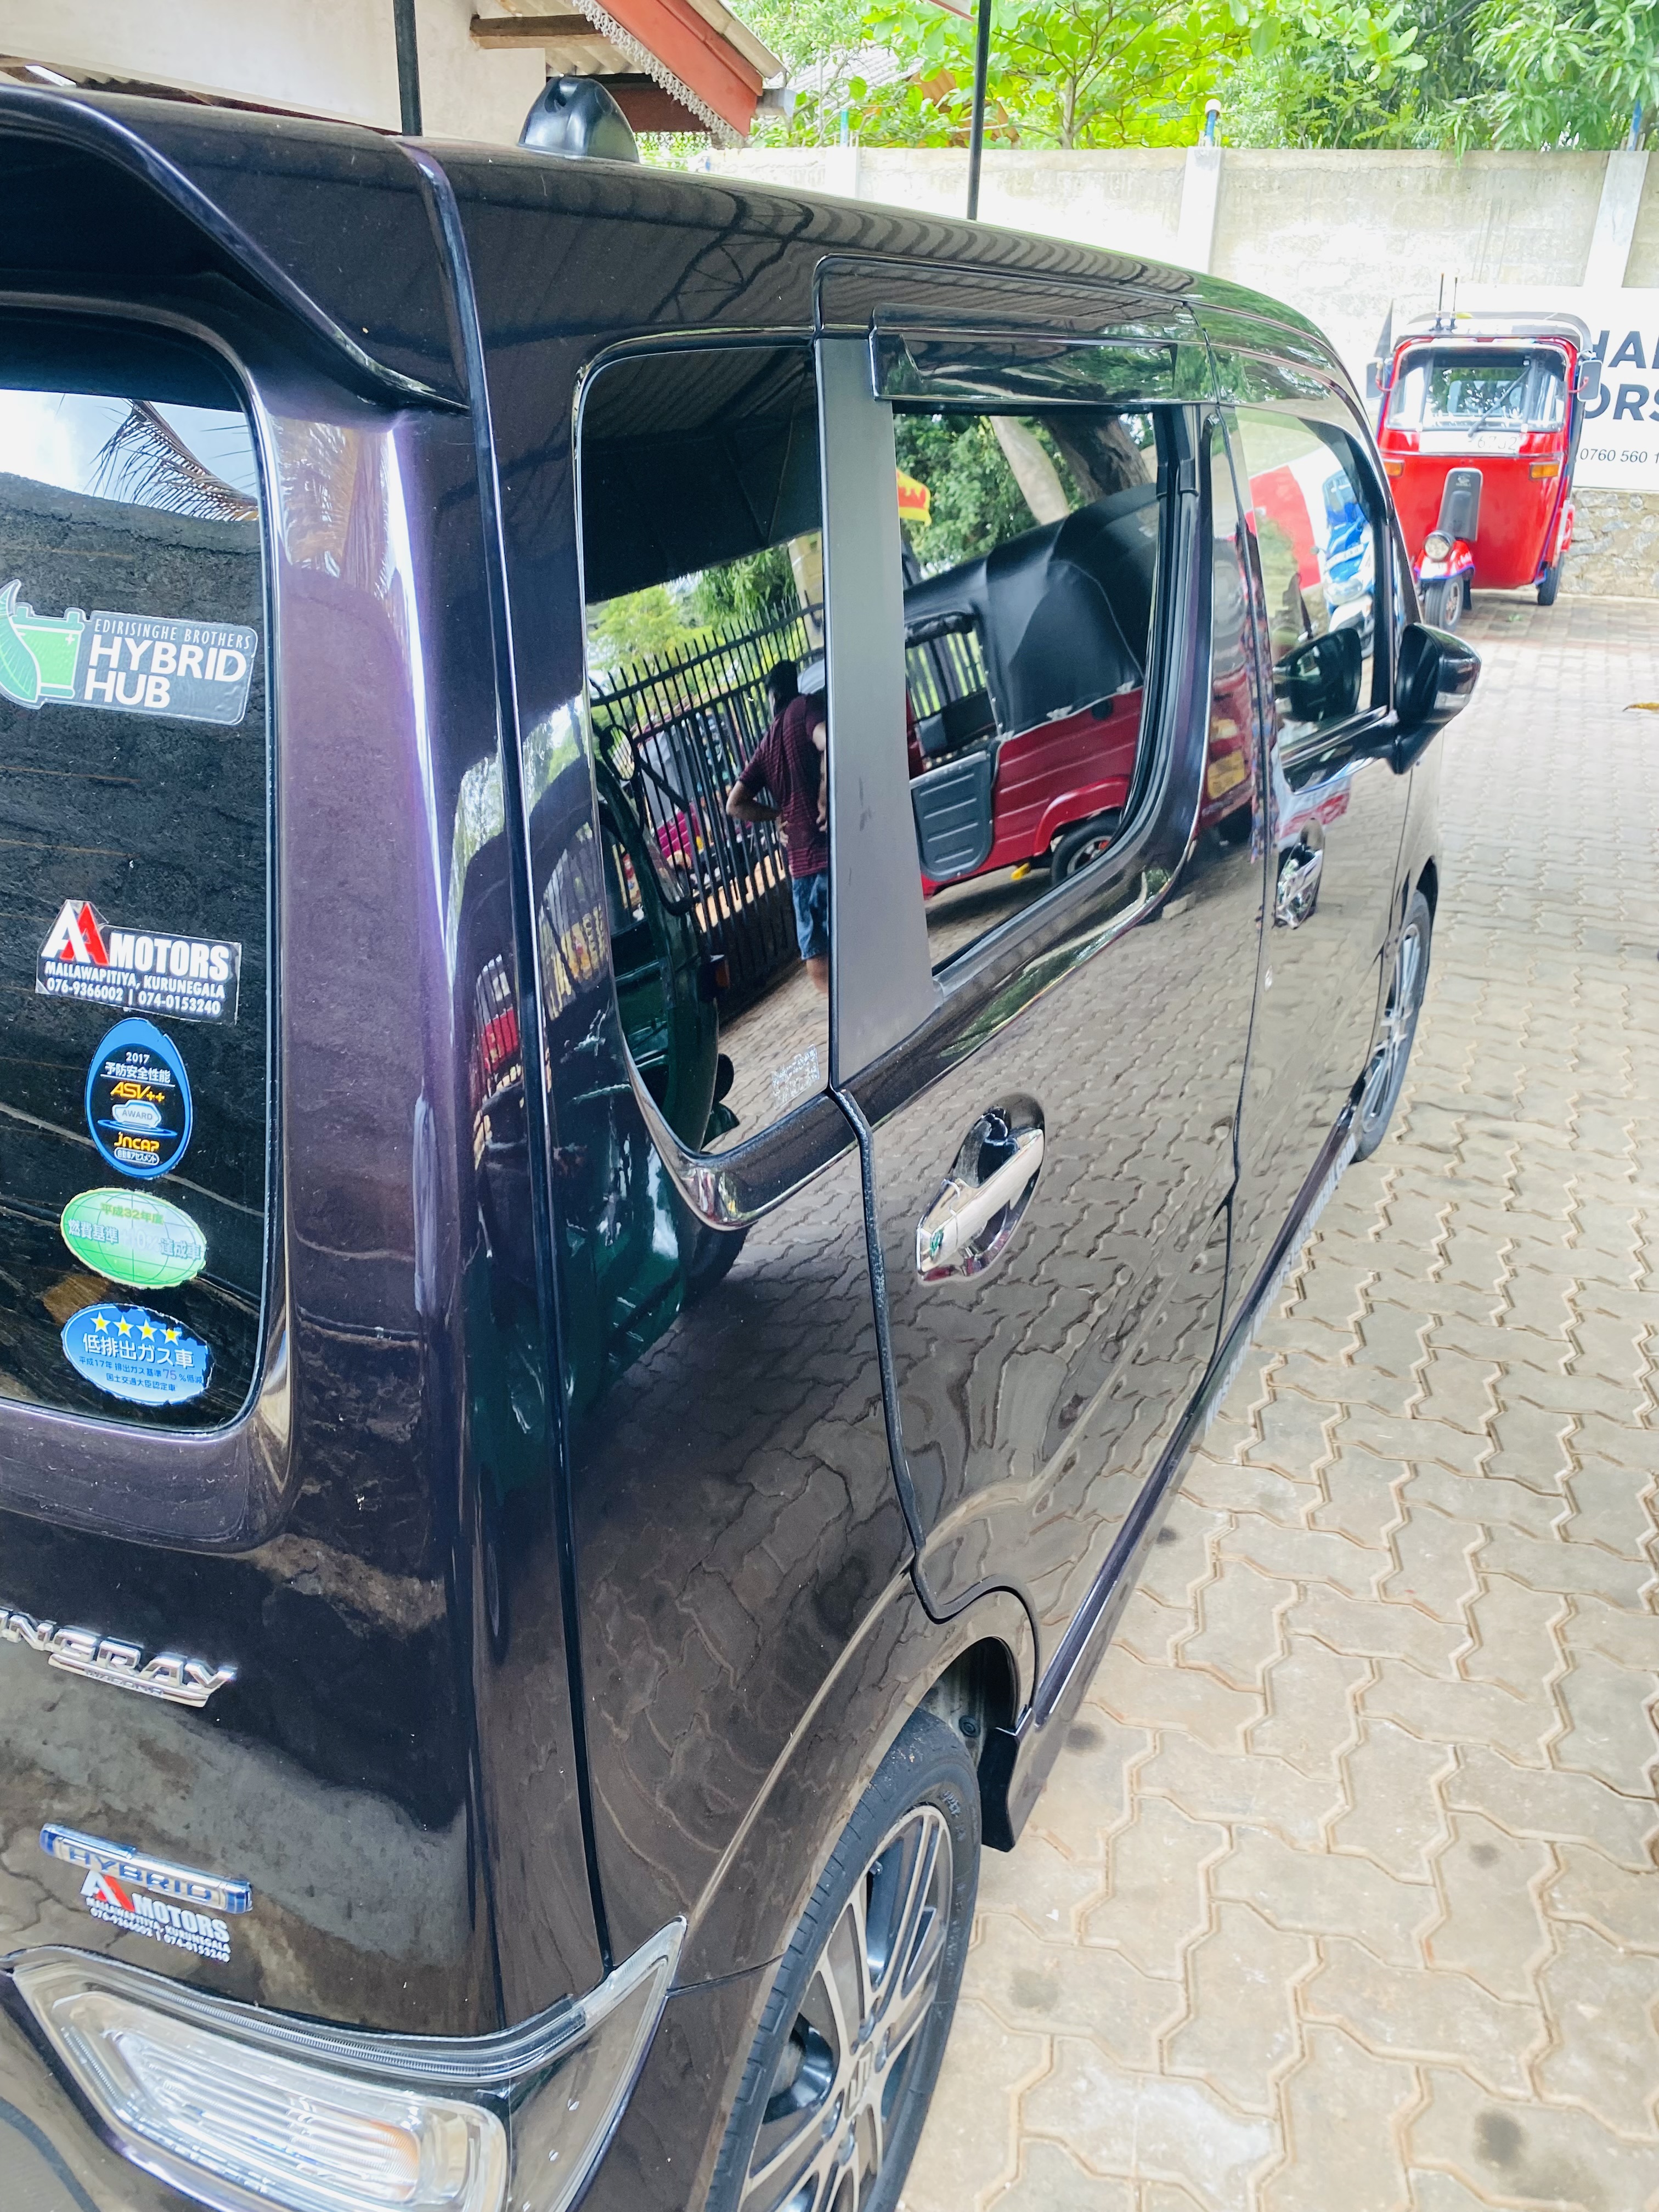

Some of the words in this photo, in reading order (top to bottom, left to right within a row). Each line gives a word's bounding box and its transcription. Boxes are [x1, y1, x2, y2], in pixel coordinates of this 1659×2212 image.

[1580, 448, 1616, 461] 0760
[1620, 450, 1647, 463] 560
[94, 618, 178, 641] EDIRISINGHE
[184, 628, 251, 650] BROTHERS
[88, 634, 247, 682] HYBRID
[84, 668, 171, 709] HUB
[109, 931, 229, 981] MOTORS
[45, 961, 140, 989] MALLAWAPITIYA,
[144, 974, 225, 999] KURUNEGALA
[47, 977, 123, 1002] 076-9366002
[138, 992, 221, 1015] 074-0153240
[105, 1061, 171, 1084] 予防安全性能
[126, 1051, 150, 1065] 2017
[122, 1109, 153, 1121] AWARD
[83, 1333, 194, 1369] 低排出ガス車
[69, 1847, 212, 1902] HYBRID
[132, 1892, 230, 1943] MOTORS
